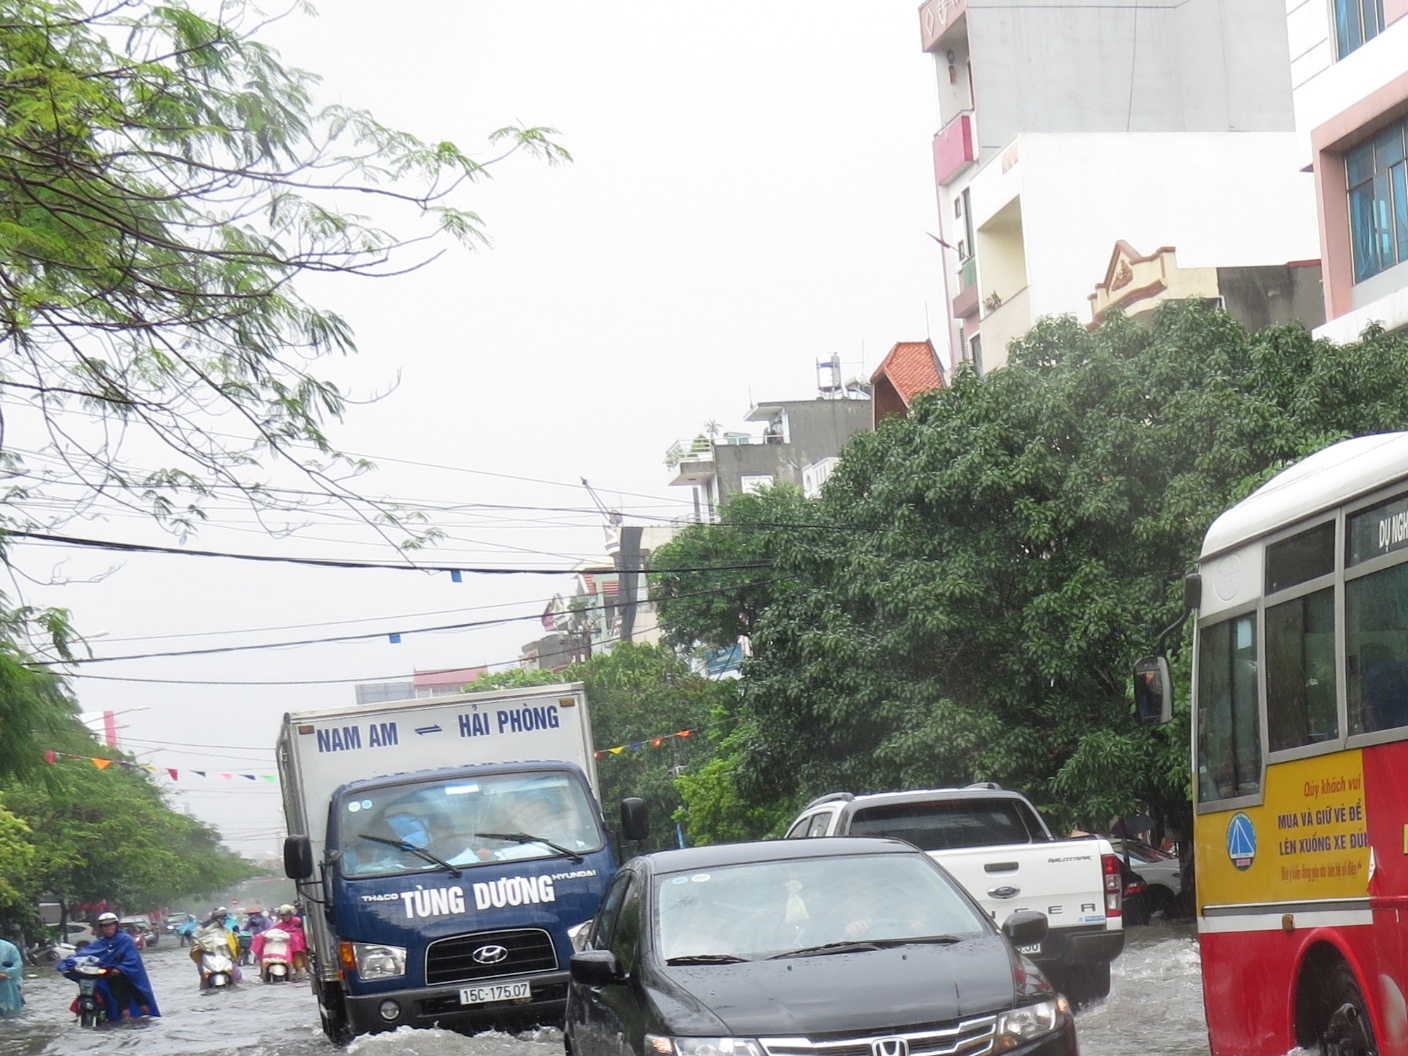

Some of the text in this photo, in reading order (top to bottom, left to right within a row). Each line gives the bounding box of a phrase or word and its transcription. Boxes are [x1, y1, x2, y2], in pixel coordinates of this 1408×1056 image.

[1379, 517, 1391, 552] DỤ
[458, 702, 560, 738] HẢI PHÒNG
[317, 722, 399, 753] NAM AM
[1321, 775, 1346, 795] khách
[1278, 813, 1299, 829] MUA
[1301, 807, 1313, 827] VÀ
[1334, 803, 1347, 823] VÉ
[1299, 831, 1331, 854] XUỐNG
[1334, 834, 1347, 850] XE
[553, 869, 597, 881] HYUNDAI
[362, 892, 399, 902] THACO
[400, 874, 556, 919] TÙNG DƯƠNG
[463, 983, 529, 1003] 15C-175.07
